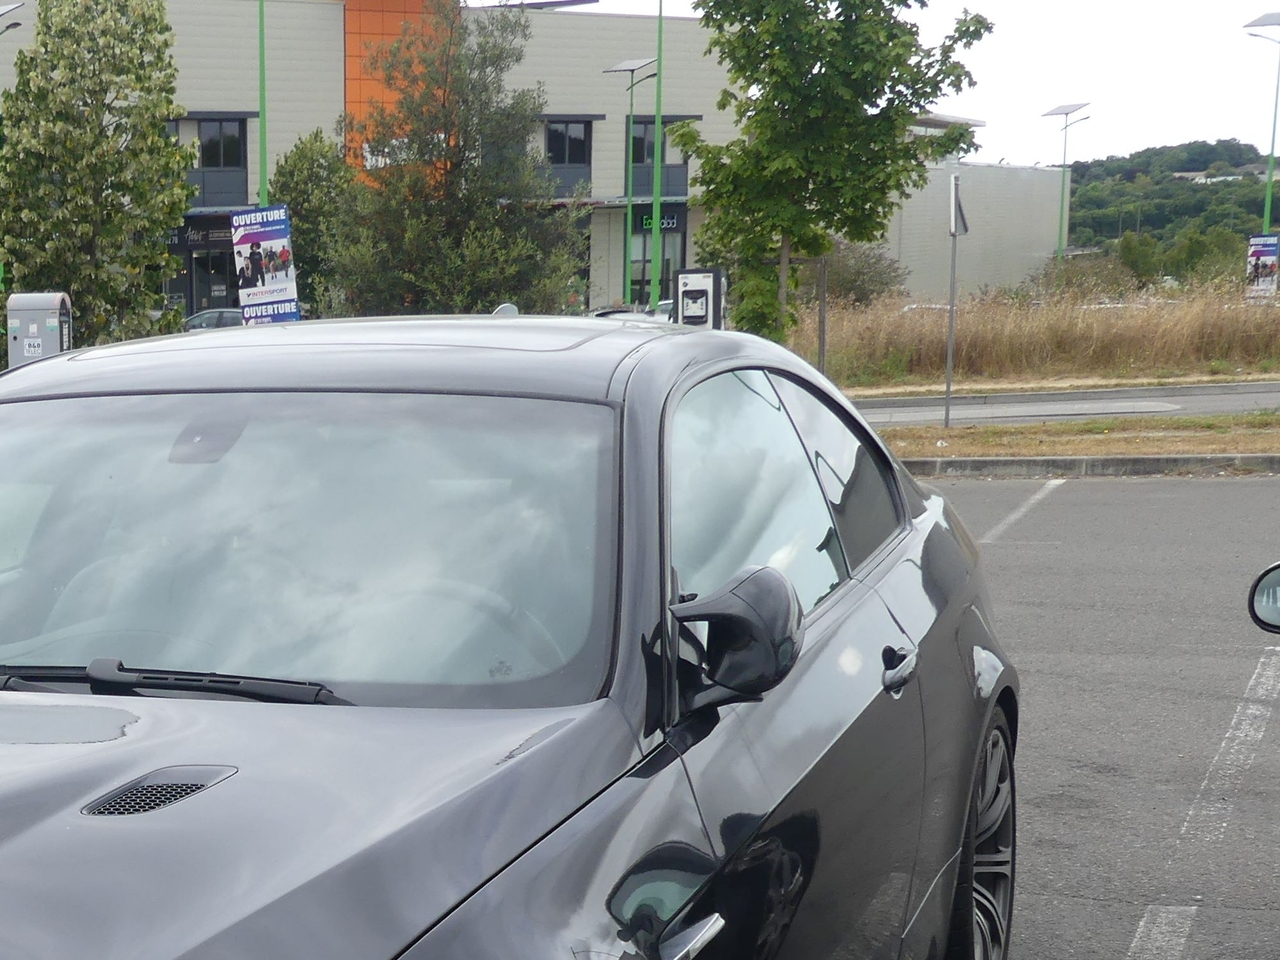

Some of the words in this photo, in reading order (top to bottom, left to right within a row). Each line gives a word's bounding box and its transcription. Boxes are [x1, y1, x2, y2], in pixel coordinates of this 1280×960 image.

[233, 209, 286, 226] OUVERTURE
[251, 287, 288, 298] INTERSPORT
[243, 302, 297, 318] OUVERTURE
